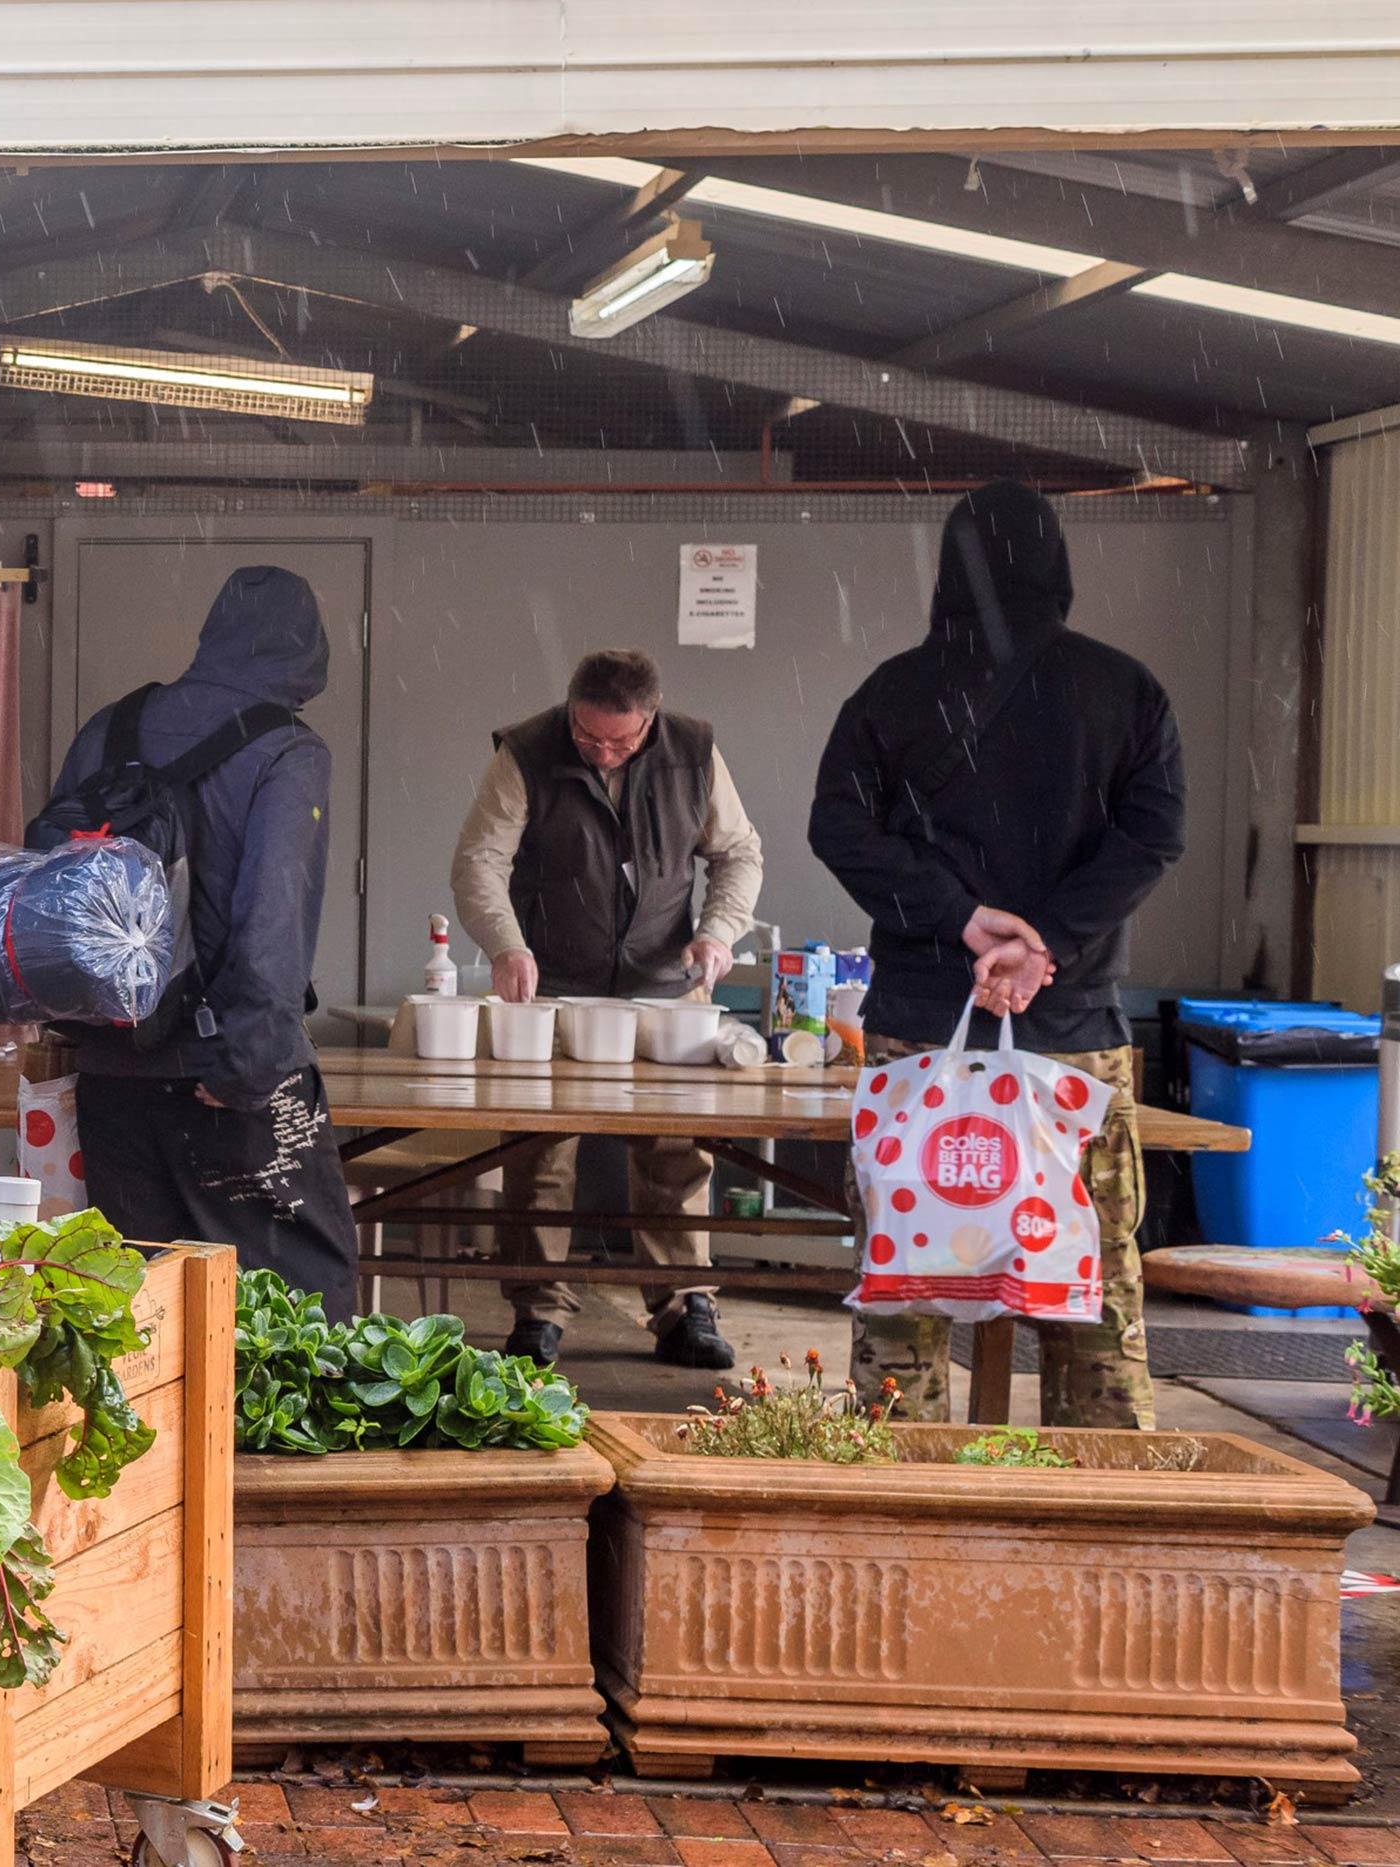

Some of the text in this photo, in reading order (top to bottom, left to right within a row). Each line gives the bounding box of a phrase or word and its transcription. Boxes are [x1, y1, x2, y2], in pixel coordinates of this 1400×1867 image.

[939, 1132, 1002, 1151] coles
[938, 1150, 1001, 1165] BETTER
[937, 1163, 1002, 1189] BAG
